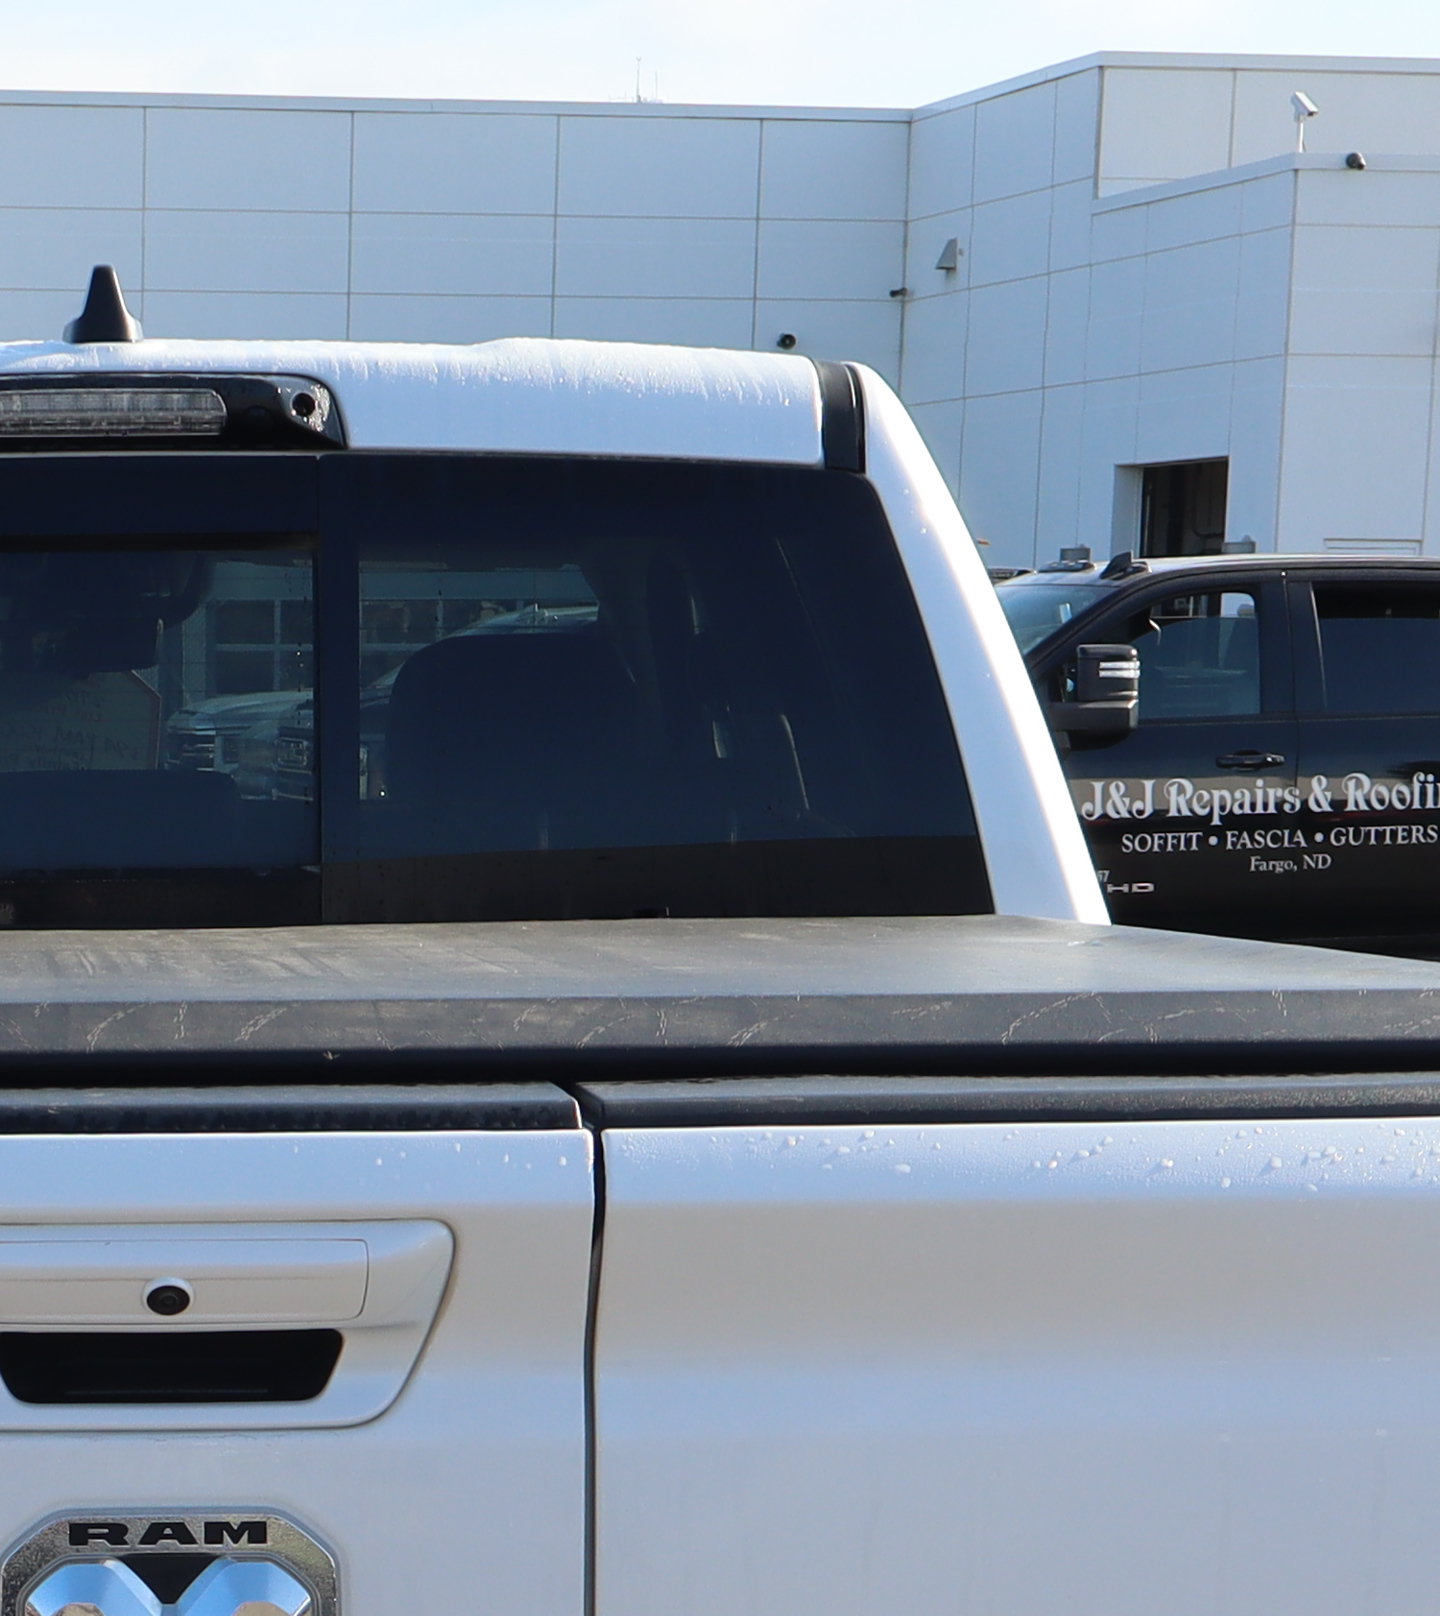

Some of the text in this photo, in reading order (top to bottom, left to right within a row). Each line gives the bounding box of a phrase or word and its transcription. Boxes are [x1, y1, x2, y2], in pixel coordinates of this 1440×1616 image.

[1081, 779, 1156, 821] J&J
[1163, 778, 1301, 825] Repairs
[1307, 774, 1334, 815] &
[1121, 824, 1439, 854] SOFFIT FASCIA GUTTERS
[1249, 853, 1332, 874] Fargo, ND
[68, 1520, 268, 1547] RAM
